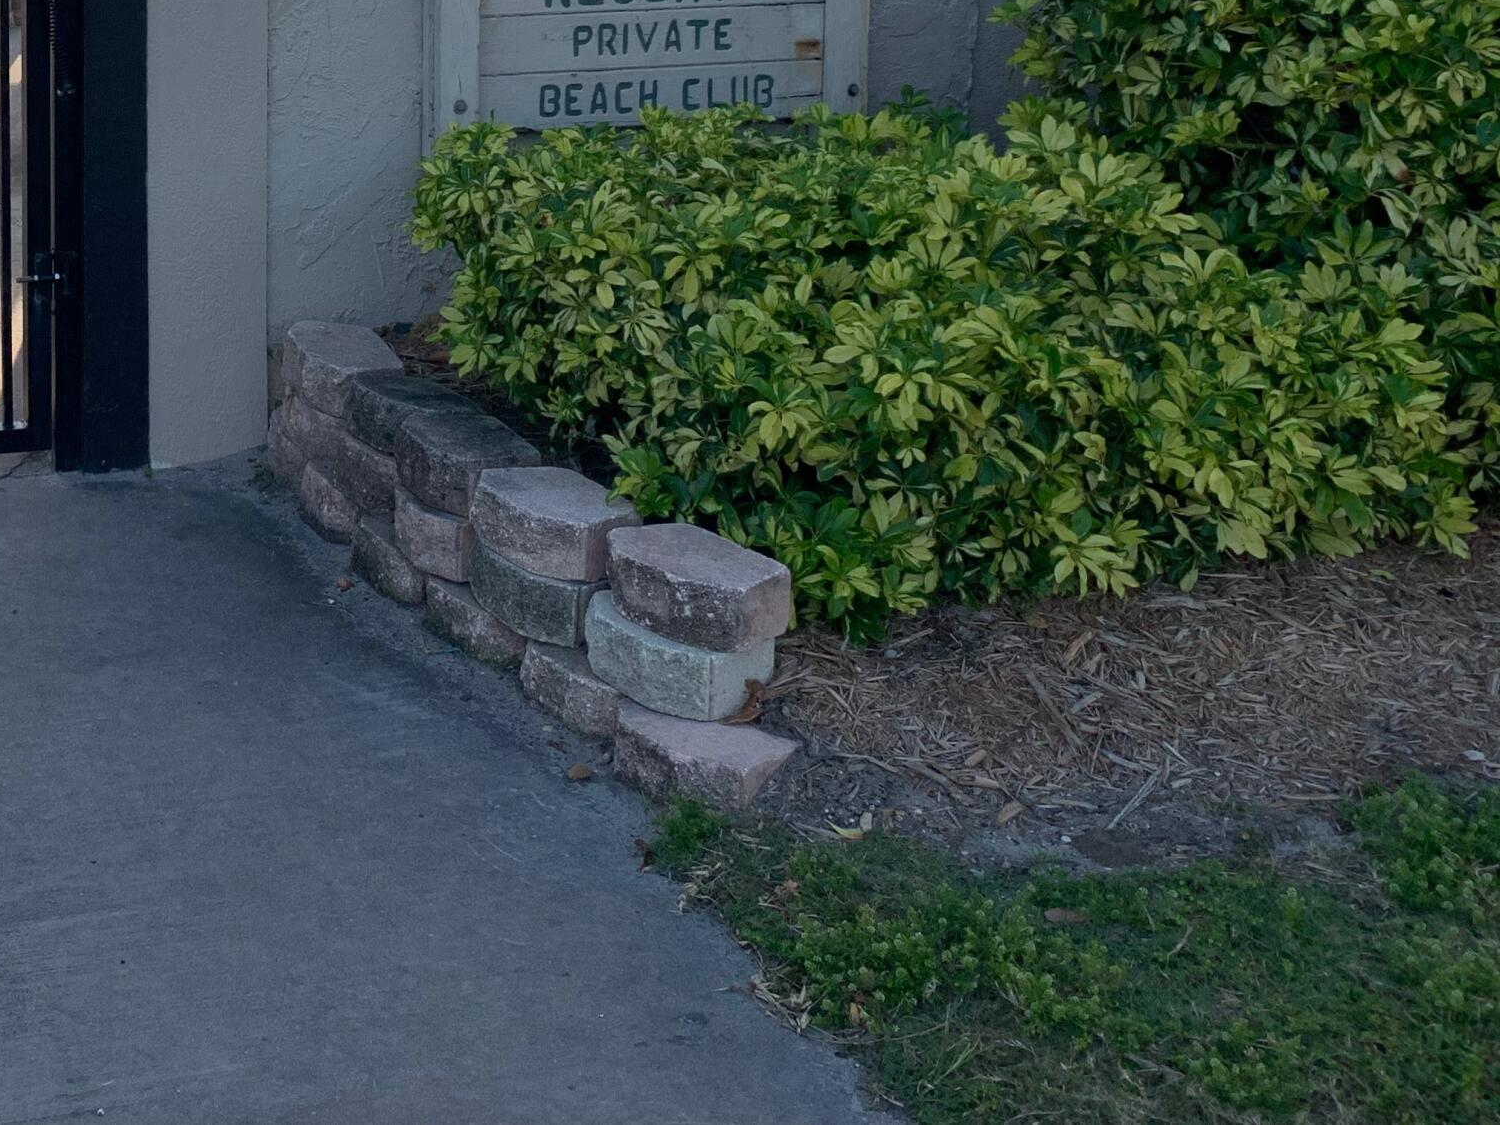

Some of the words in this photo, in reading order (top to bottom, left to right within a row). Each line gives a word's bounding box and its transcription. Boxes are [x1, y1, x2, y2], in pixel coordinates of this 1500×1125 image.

[573, 18, 733, 57] PRIVATE
[539, 79, 658, 117] BEACH
[682, 74, 774, 111] CLUB
